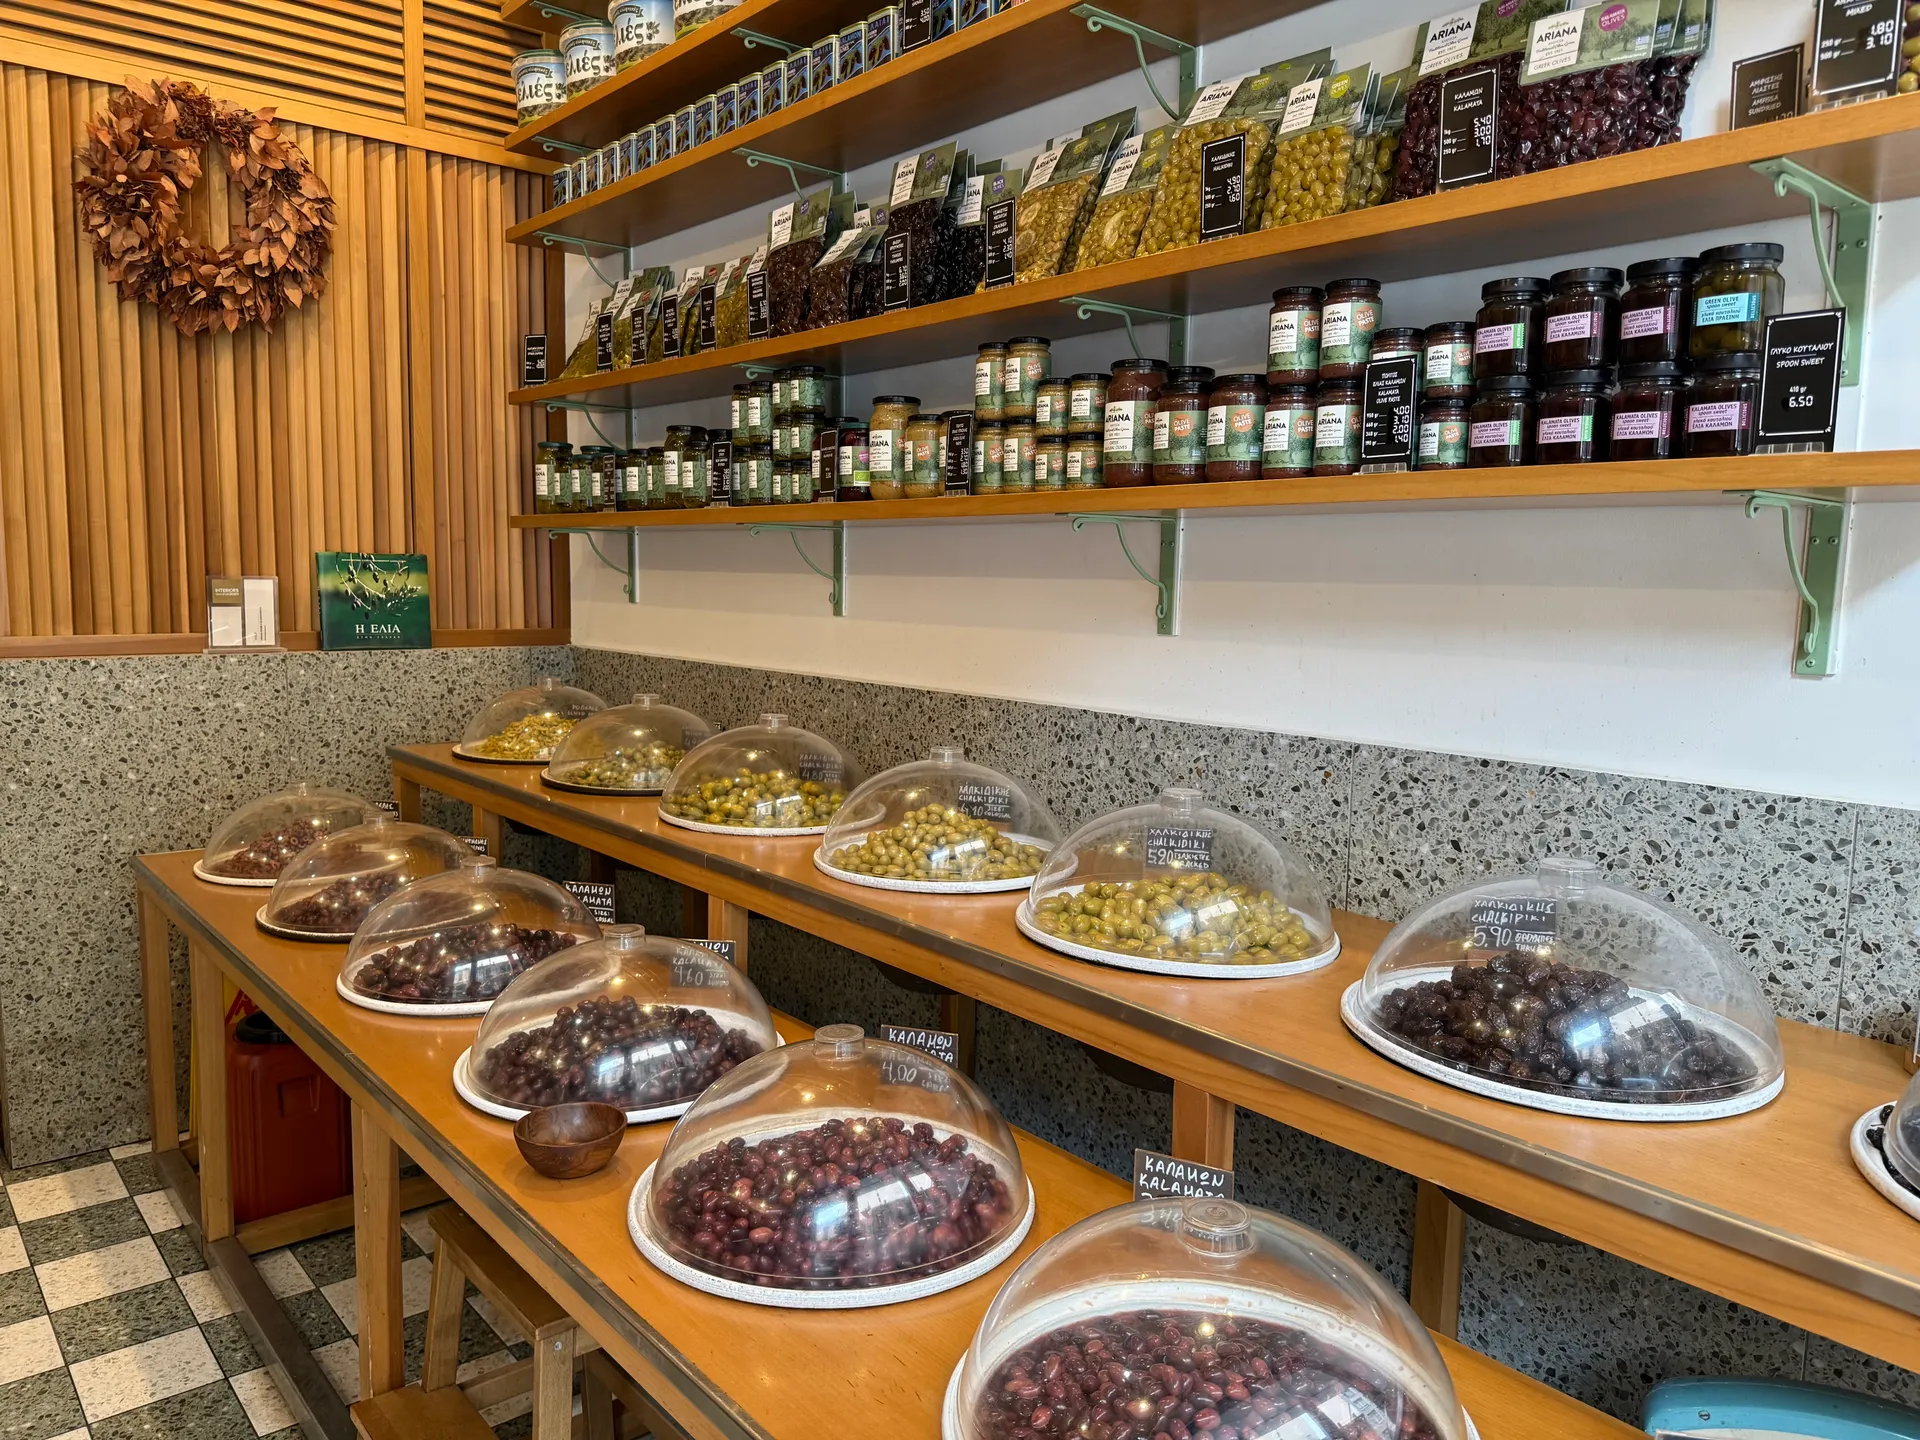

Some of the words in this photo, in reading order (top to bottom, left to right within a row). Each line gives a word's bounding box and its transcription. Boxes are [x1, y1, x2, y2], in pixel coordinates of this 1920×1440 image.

[1846, 3, 1873, 17] MIXED
[1601, 14, 1626, 28] OLIVES
[1430, 21, 1472, 43] ARIANA
[1536, 26, 1577, 43] ARIANA
[1199, 90, 1233, 103] ARIANA
[1289, 92, 1316, 107] ARIANA
[1723, 296, 1740, 304] OLIVE
[1324, 316, 1348, 325] ARIANA
[1356, 311, 1374, 321] OLIVE
[1358, 316, 1375, 326] PASTE
[1271, 323, 1295, 331] ARIANA
[1770, 346, 1792, 356] ΓΛΥΚΟ
[1793, 342, 1834, 354] ΚΟΥΤΑΛΙΟΥ
[1776, 360, 1800, 369] SPOON
[1800, 357, 1825, 367] SWEET
[1789, 395, 1814, 408] 6.50
[1173, 418, 1191, 427] OLIVE
[1233, 413, 1251, 422] OLIVE
[1174, 424, 1191, 432] PASTE
[1234, 419, 1252, 428] PASTE
[1297, 420, 1313, 428] OLIVE
[917, 450, 930, 458] PASTE
[355, 624, 365, 634] Η
[371, 624, 401, 634] ΕΛΙΑ
[959, 794, 1008, 805] CHALKIDIKI
[1149, 828, 1212, 838] ΧΑΛΚΙΔΙΚΗΣ
[1148, 837, 1205, 849] CHALKIDIKI
[1475, 900, 1556, 914] ΧΑΛΚΙΔΙΚΗΣ
